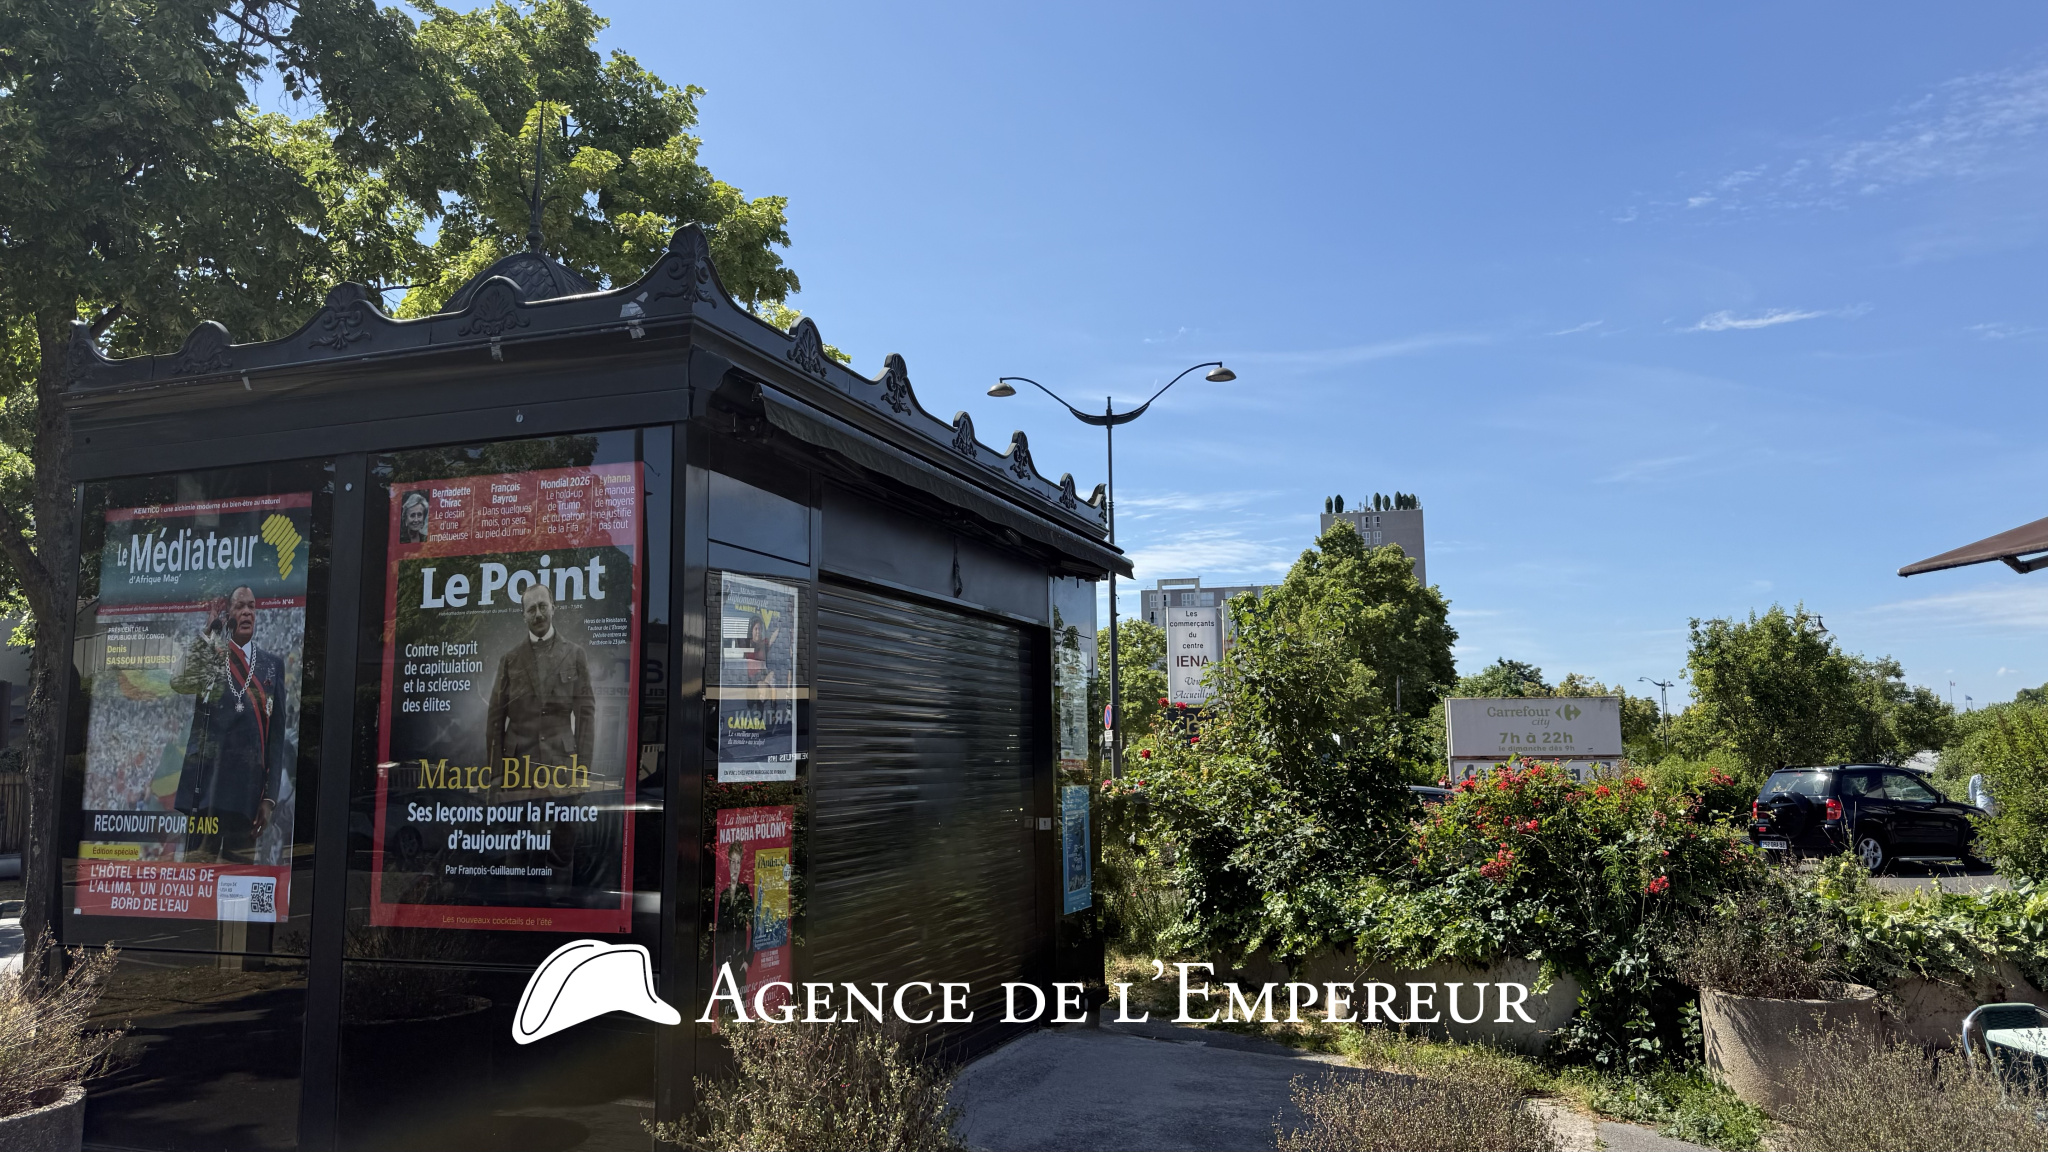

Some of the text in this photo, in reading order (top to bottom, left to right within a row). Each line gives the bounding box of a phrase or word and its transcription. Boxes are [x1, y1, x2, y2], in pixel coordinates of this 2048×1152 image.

[491, 482, 520, 493] François
[540, 476, 590, 490] Mondial 2026
[432, 487, 471, 498] Bernadette
[546, 489, 584, 501] Le hold-up
[595, 486, 635, 496] Le manque
[196, 502, 220, 510] moderne
[261, 497, 281, 505] naturel
[440, 499, 462, 508] Chirac
[492, 495, 518, 505] Bayrou
[547, 501, 581, 511] de Trump
[595, 498, 634, 508] de moyens
[435, 509, 465, 520] Le destin
[500, 505, 532, 515] quelques
[606, 508, 632, 519] justifie
[482, 516, 526, 528] mois, on sera
[542, 512, 585, 523] et du patron
[440, 521, 459, 530] d'une
[548, 524, 557, 534] de
[558, 524, 564, 532] la
[598, 520, 628, 531] pas tout
[430, 532, 469, 543] impétueuse
[475, 528, 511, 540] au pied du
[117, 527, 258, 573] Le Médiateur
[128, 575, 161, 585] d'Afrique
[420, 554, 606, 609] Le Point
[107, 644, 127, 653] Denis
[405, 641, 478, 657] Contre l'esprit
[106, 655, 177, 665] SASSOU N'GUESSO
[1176, 655, 1209, 667] IENA
[404, 658, 482, 677] de capitulation
[404, 677, 470, 693] et la sclérose
[402, 697, 451, 712] des élites
[1487, 706, 1551, 717] Carrefour
[1531, 718, 1550, 728] city
[1500, 732, 1573, 743] 7h à 22h
[418, 754, 590, 789] Marc Bloch
[407, 801, 598, 826] Ses leçons pour la France
[94, 814, 219, 834] RECONDUIT POUR 5 ANS
[724, 814, 734, 826] La
[720, 822, 787, 844] NATACHA POLONY
[447, 829, 551, 853] d'aujourd'hui
[114, 848, 139, 856] spéciale
[90, 862, 215, 882] L'HÔTEL LES RELAIS DE
[445, 865, 552, 877] Par François-Guillaume Lorrain
[89, 880, 135, 896] L'ALIMA,
[140, 882, 156, 895] UN
[159, 883, 194, 897] JOYAU
[198, 885, 213, 898] AU
[111, 896, 189, 912] BORD DE L'EAU
[443, 914, 552, 926] Les nouveaux cocktails de l'été
